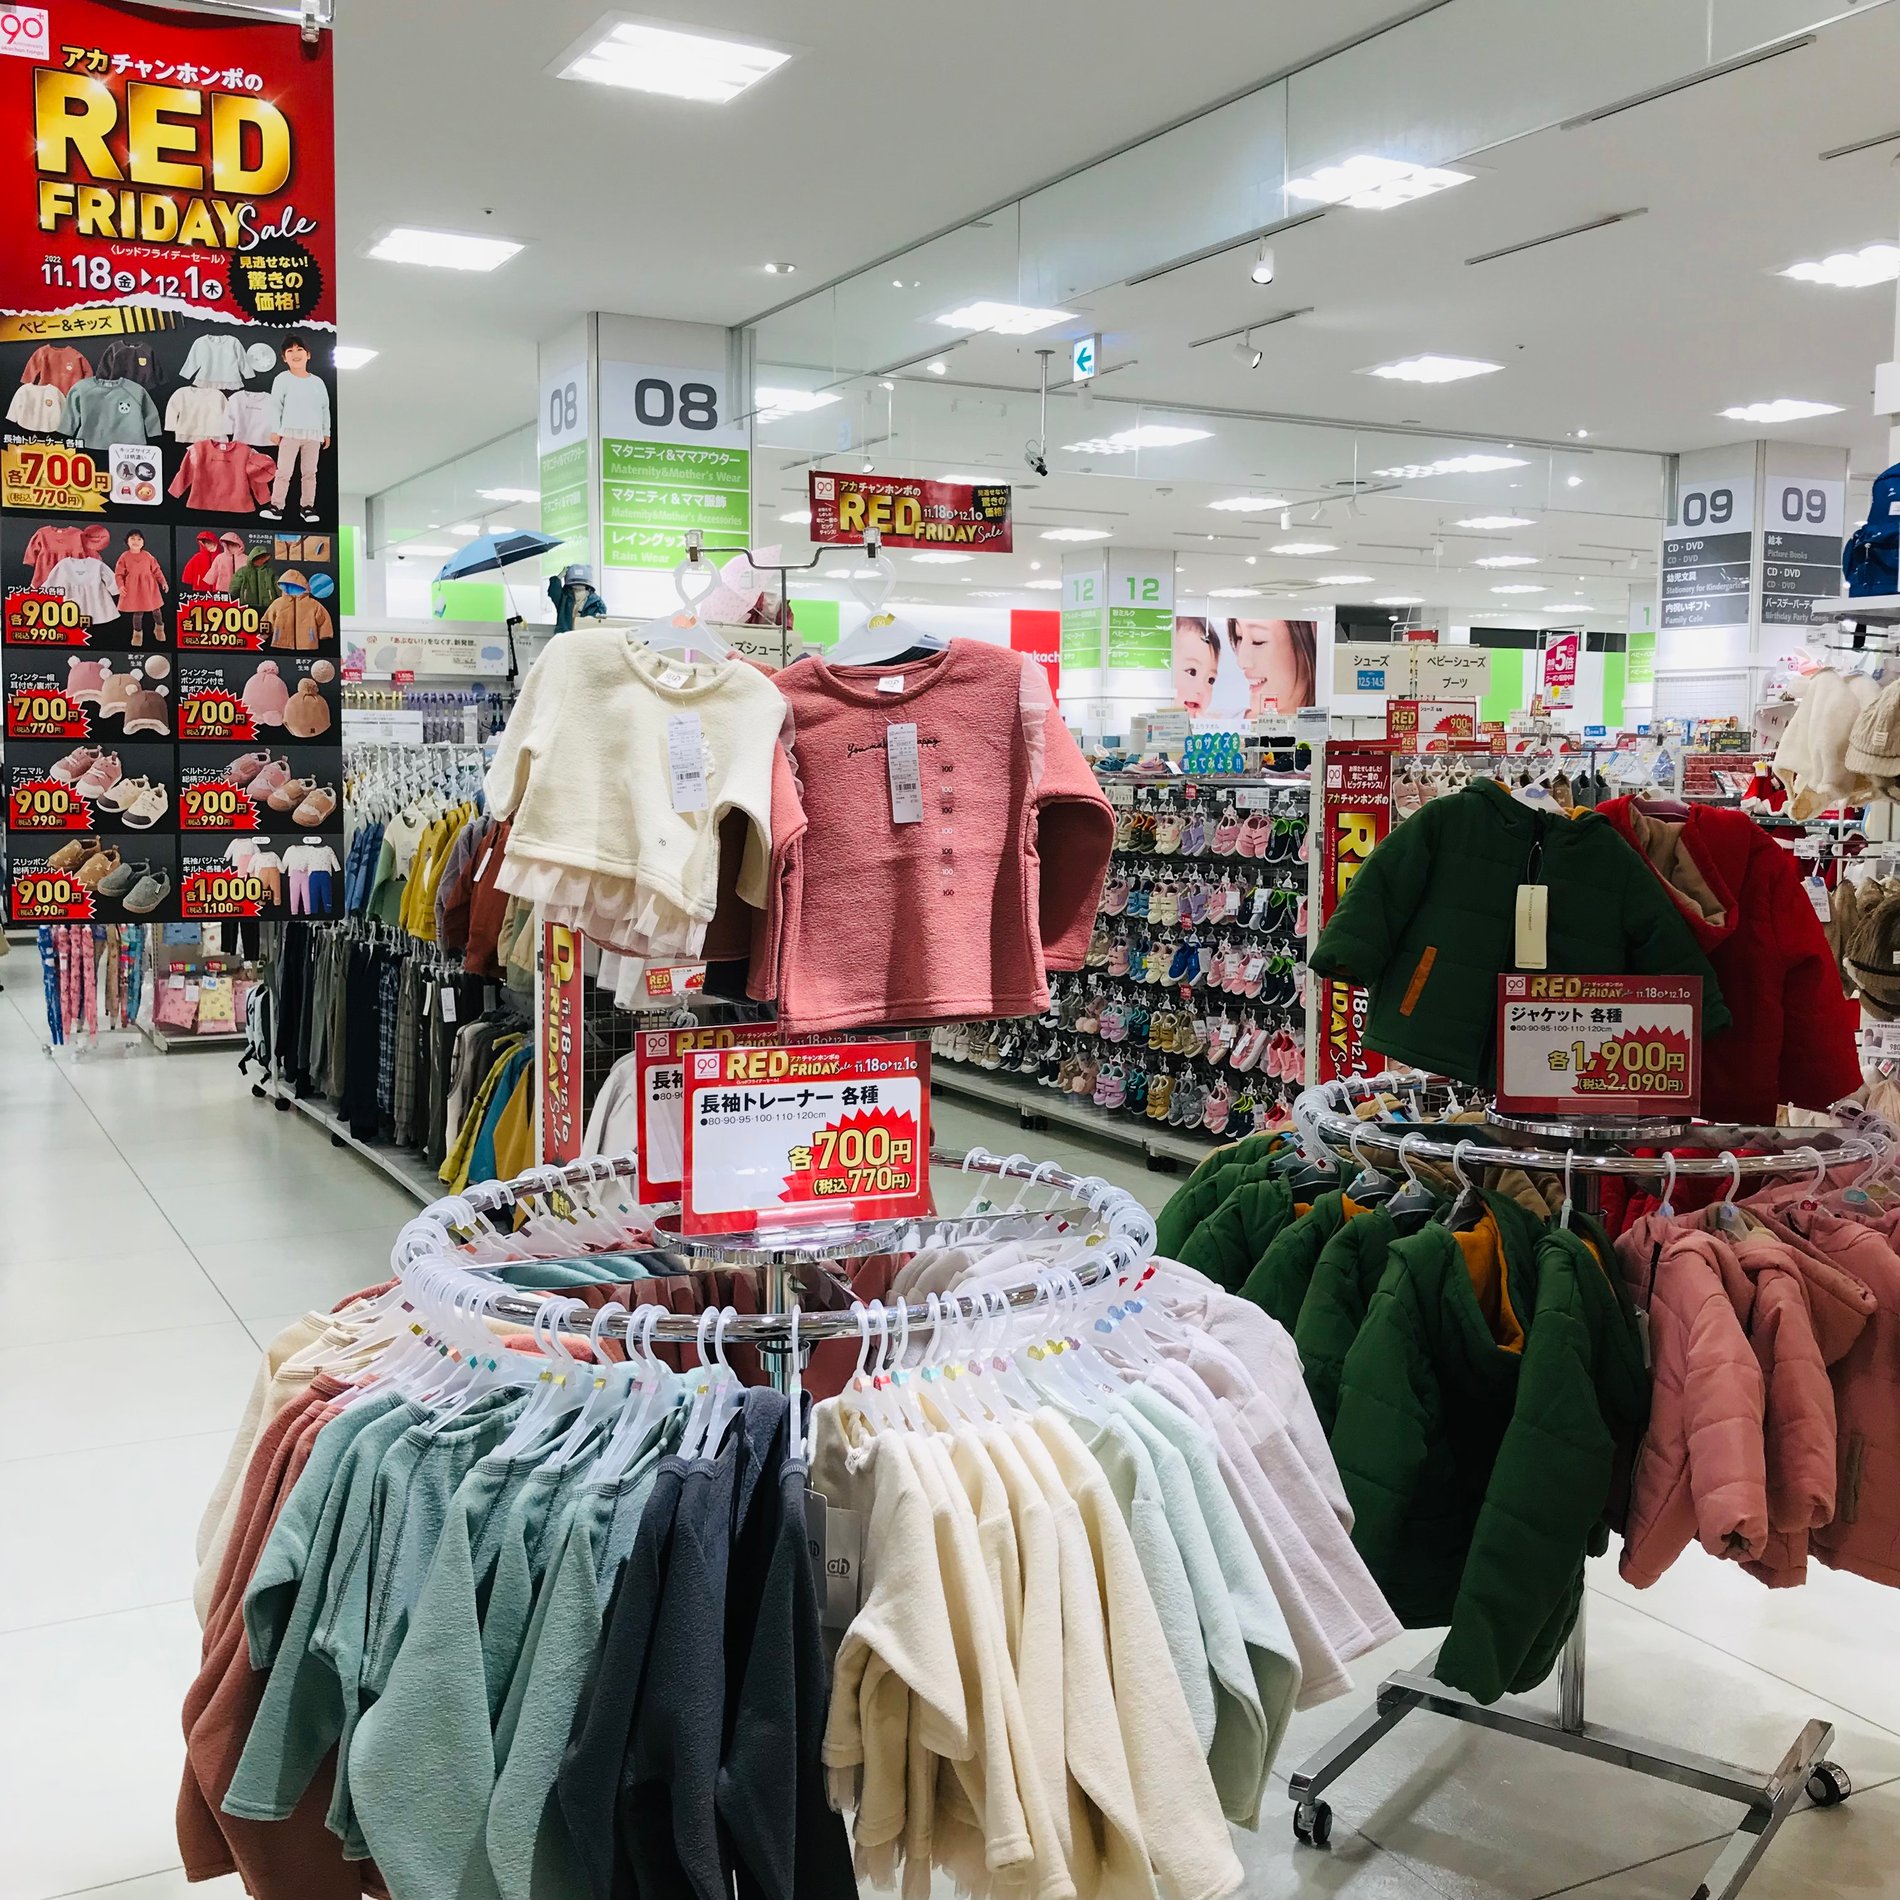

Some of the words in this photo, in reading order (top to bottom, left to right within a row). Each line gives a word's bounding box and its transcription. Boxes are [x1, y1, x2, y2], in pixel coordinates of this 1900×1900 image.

[61, 45, 264, 92] アカチャンホンポの
[34, 67, 291, 196] RED
[39, 180, 243, 249] FRIDAY
[237, 204, 317, 251] Sale
[247, 271, 304, 291] 驚きの
[254, 292, 300, 312] 価格!
[18, 315, 111, 334] ベビー&キッズ
[549, 381, 578, 436] 08
[635, 378, 718, 431] 08
[3, 434, 64, 446] 長袖トレーナー
[66, 439, 85, 448] 各種
[8, 452, 109, 490] 各700円
[716, 472, 742, 483] Wear
[839, 492, 923, 535] RED
[1682, 488, 1734, 527] 09
[1781, 486, 1827, 524] 09
[914, 521, 978, 543] FRIDAY
[976, 525, 1004, 544] Sale
[612, 550, 638, 561] Rain
[641, 551, 670, 563] Wear
[1073, 578, 1095, 602] 12
[1126, 576, 1160, 601] 12
[1696, 583, 1705, 592] for
[11, 600, 91, 628] 各900円
[182, 606, 270, 633] 各1,900円
[1353, 654, 1390, 667] シューズ
[1427, 655, 1486, 669] ベビーシューズ
[1442, 677, 1468, 689] ブーツ
[13, 696, 79, 721] 700円
[183, 700, 246, 725] 700円
[1392, 711, 1417, 725] RED
[12, 766, 44, 775] アニマル
[942, 765, 954, 773] 100
[15, 789, 81, 814] 900円
[185, 790, 247, 814] 900円
[1327, 793, 1389, 806] アカチャンホンポの
[942, 847, 954, 855] 100
[17, 880, 82, 903] 900円
[185, 878, 272, 901] 各1,000円
[1530, 976, 1582, 998] RED
[1581, 987, 1622, 998] FRIDAY
[1510, 1007, 1583, 1023] ジャケット
[1590, 1007, 1623, 1023] 各種
[548, 964, 562, 1101] FRIDAY
[727, 1051, 790, 1080] RED
[1548, 1040, 1685, 1072] 各1,900円
[789, 1062, 838, 1077] FRIDAY
[700, 1091, 834, 1114] 長袖トレーナー
[841, 1085, 879, 1106] 各種
[788, 1127, 912, 1171] 各700円
[813, 1166, 912, 1195] (税込770円)
